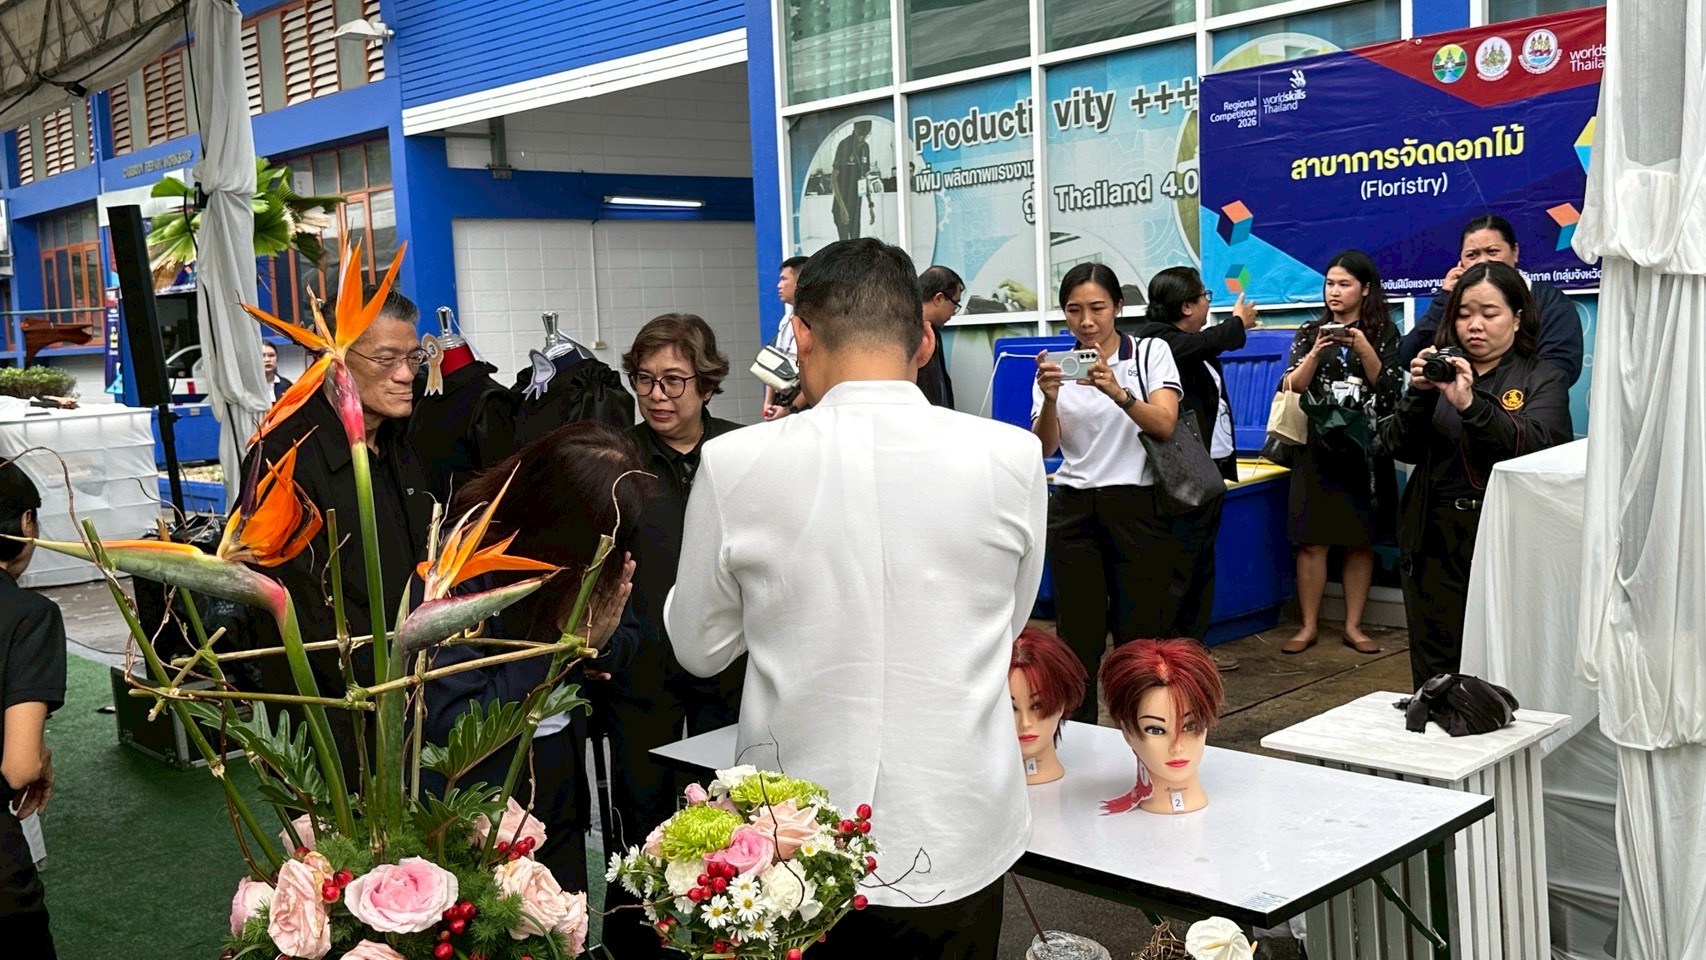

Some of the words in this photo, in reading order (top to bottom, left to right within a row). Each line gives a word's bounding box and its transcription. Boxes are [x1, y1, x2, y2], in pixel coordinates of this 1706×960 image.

[1569, 44, 1607, 60] worlds
[1569, 58, 1605, 72] Thaila
[1262, 89, 1306, 104] worldskills
[1223, 97, 1257, 111] Regional
[1263, 100, 1298, 114] Thailand
[1210, 109, 1257, 122] Competition
[1237, 117, 1257, 128] 2026
[1291, 124, 1524, 180] สาขาการจัดดอกไม้
[1054, 175, 1152, 213] Thailand
[1160, 169, 1198, 199] 4.0
[1361, 172, 1448, 200] (Floristry)
[429, 344, 436, 355] 3
[1127, 369, 1139, 377] DS
[1174, 798, 1182, 807] 2
